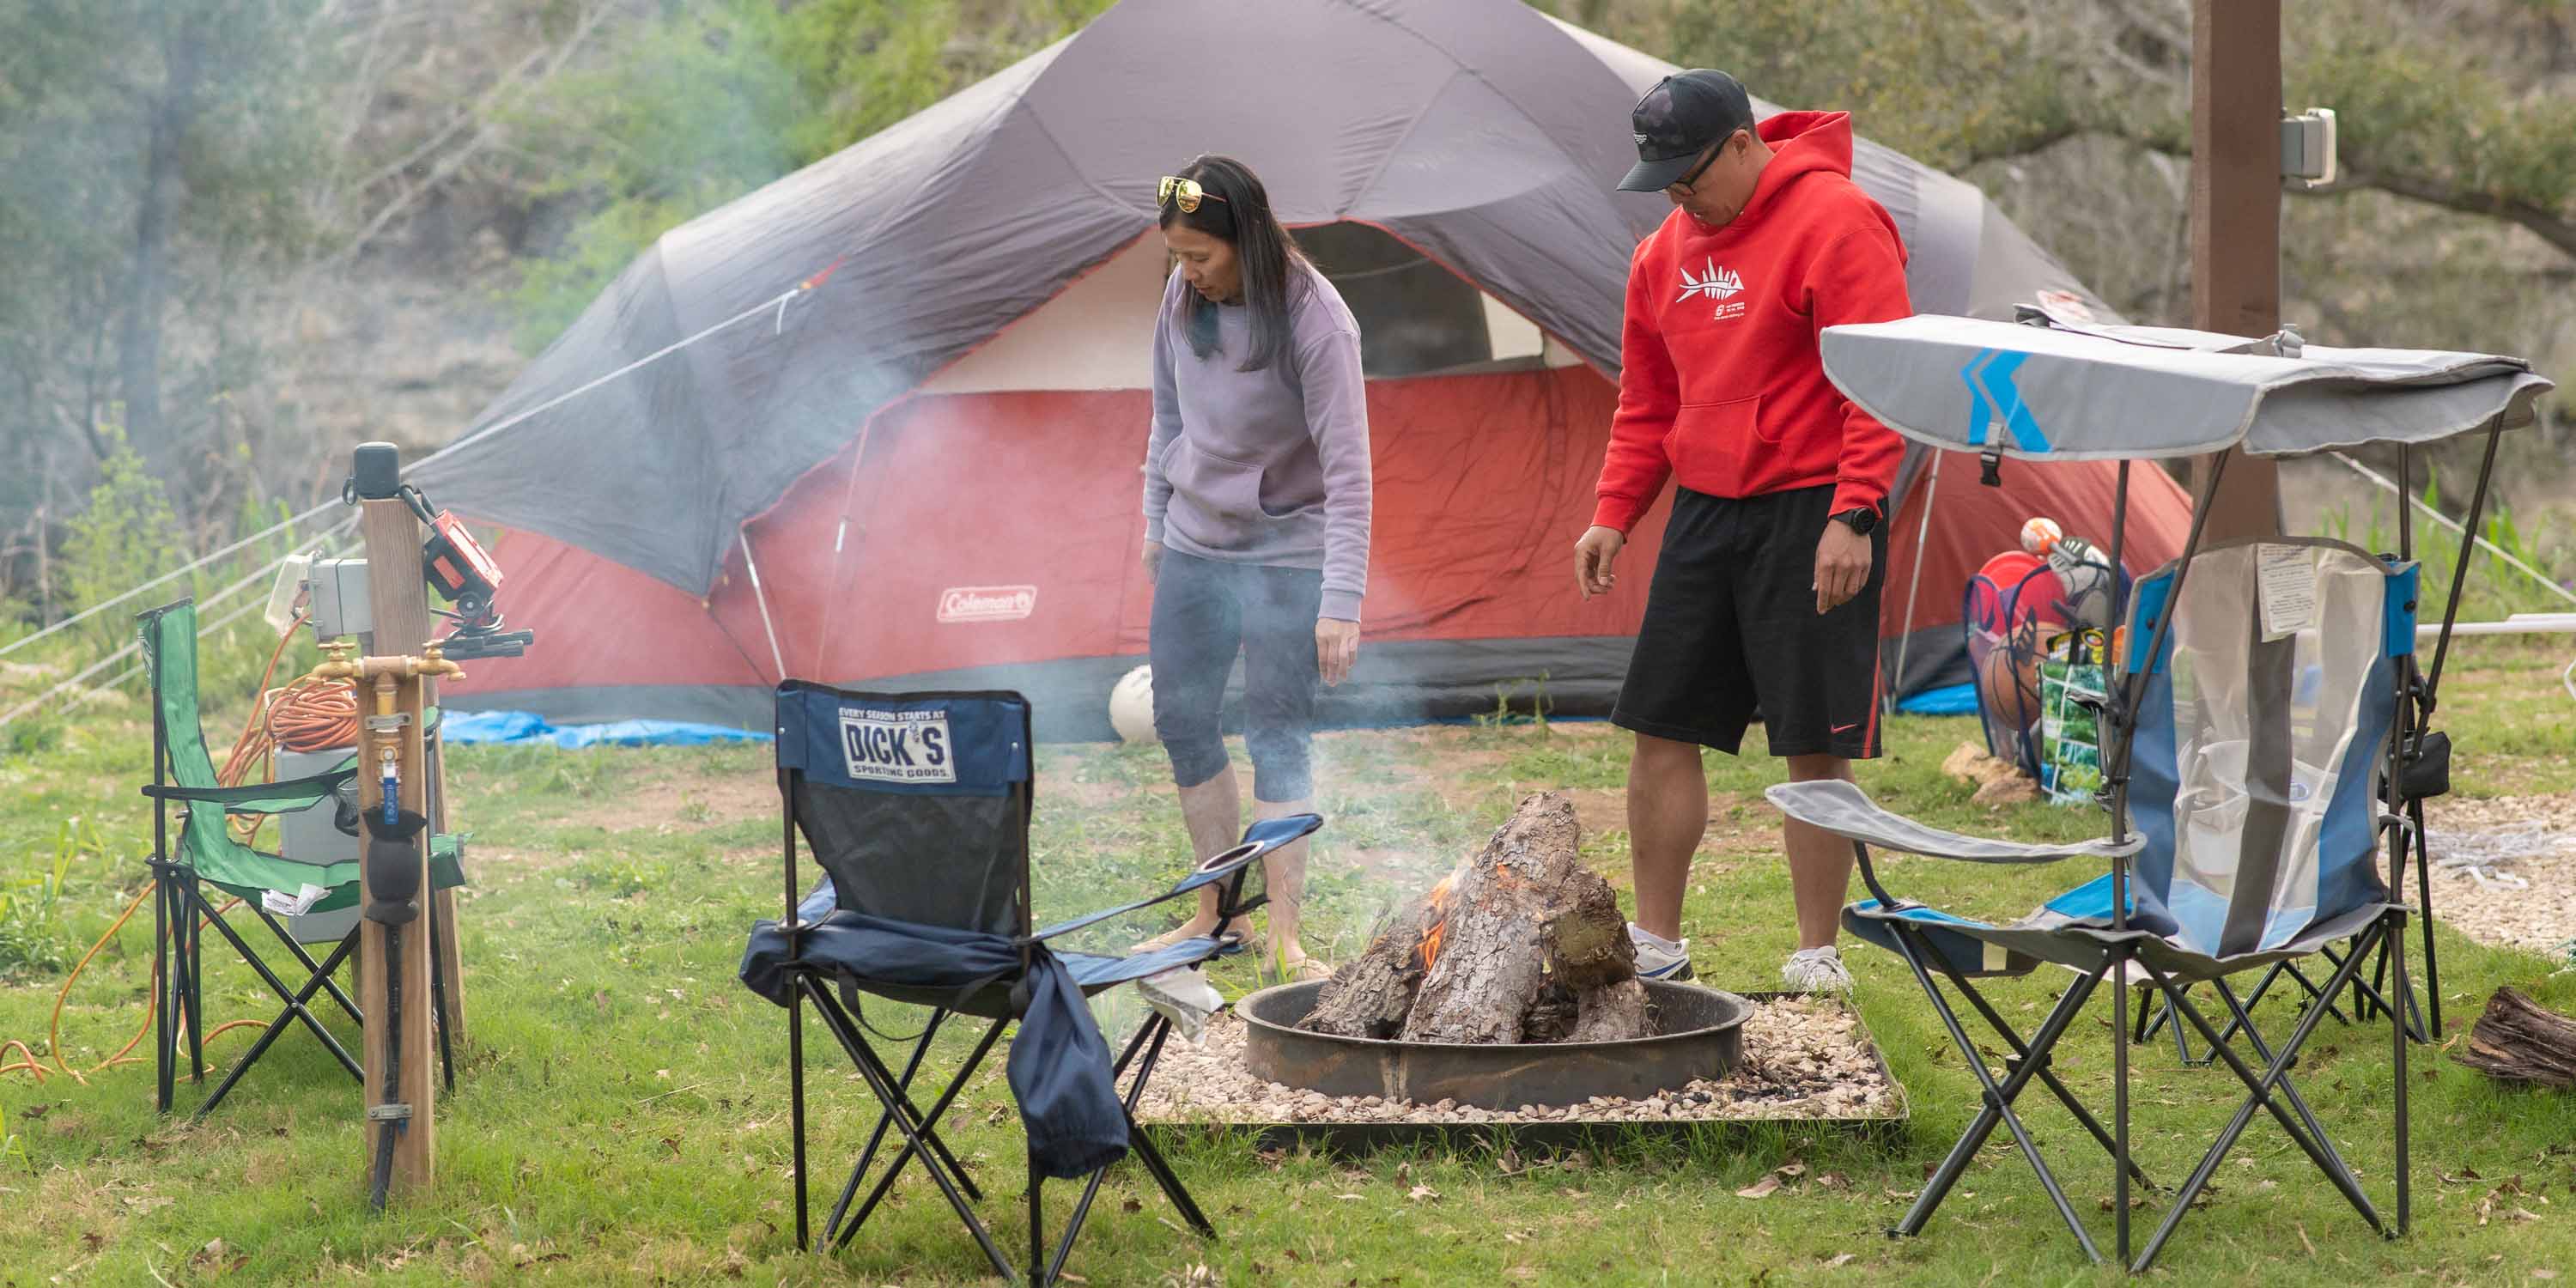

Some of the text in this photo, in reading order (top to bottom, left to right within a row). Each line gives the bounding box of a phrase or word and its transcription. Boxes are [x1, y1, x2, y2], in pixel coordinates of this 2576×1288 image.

[945, 593, 1018, 615] Coleman
[838, 708, 945, 722] EVERY SEASON STARTS AT
[845, 724, 945, 766] DICK'S
[854, 765, 903, 776] SPORTING
